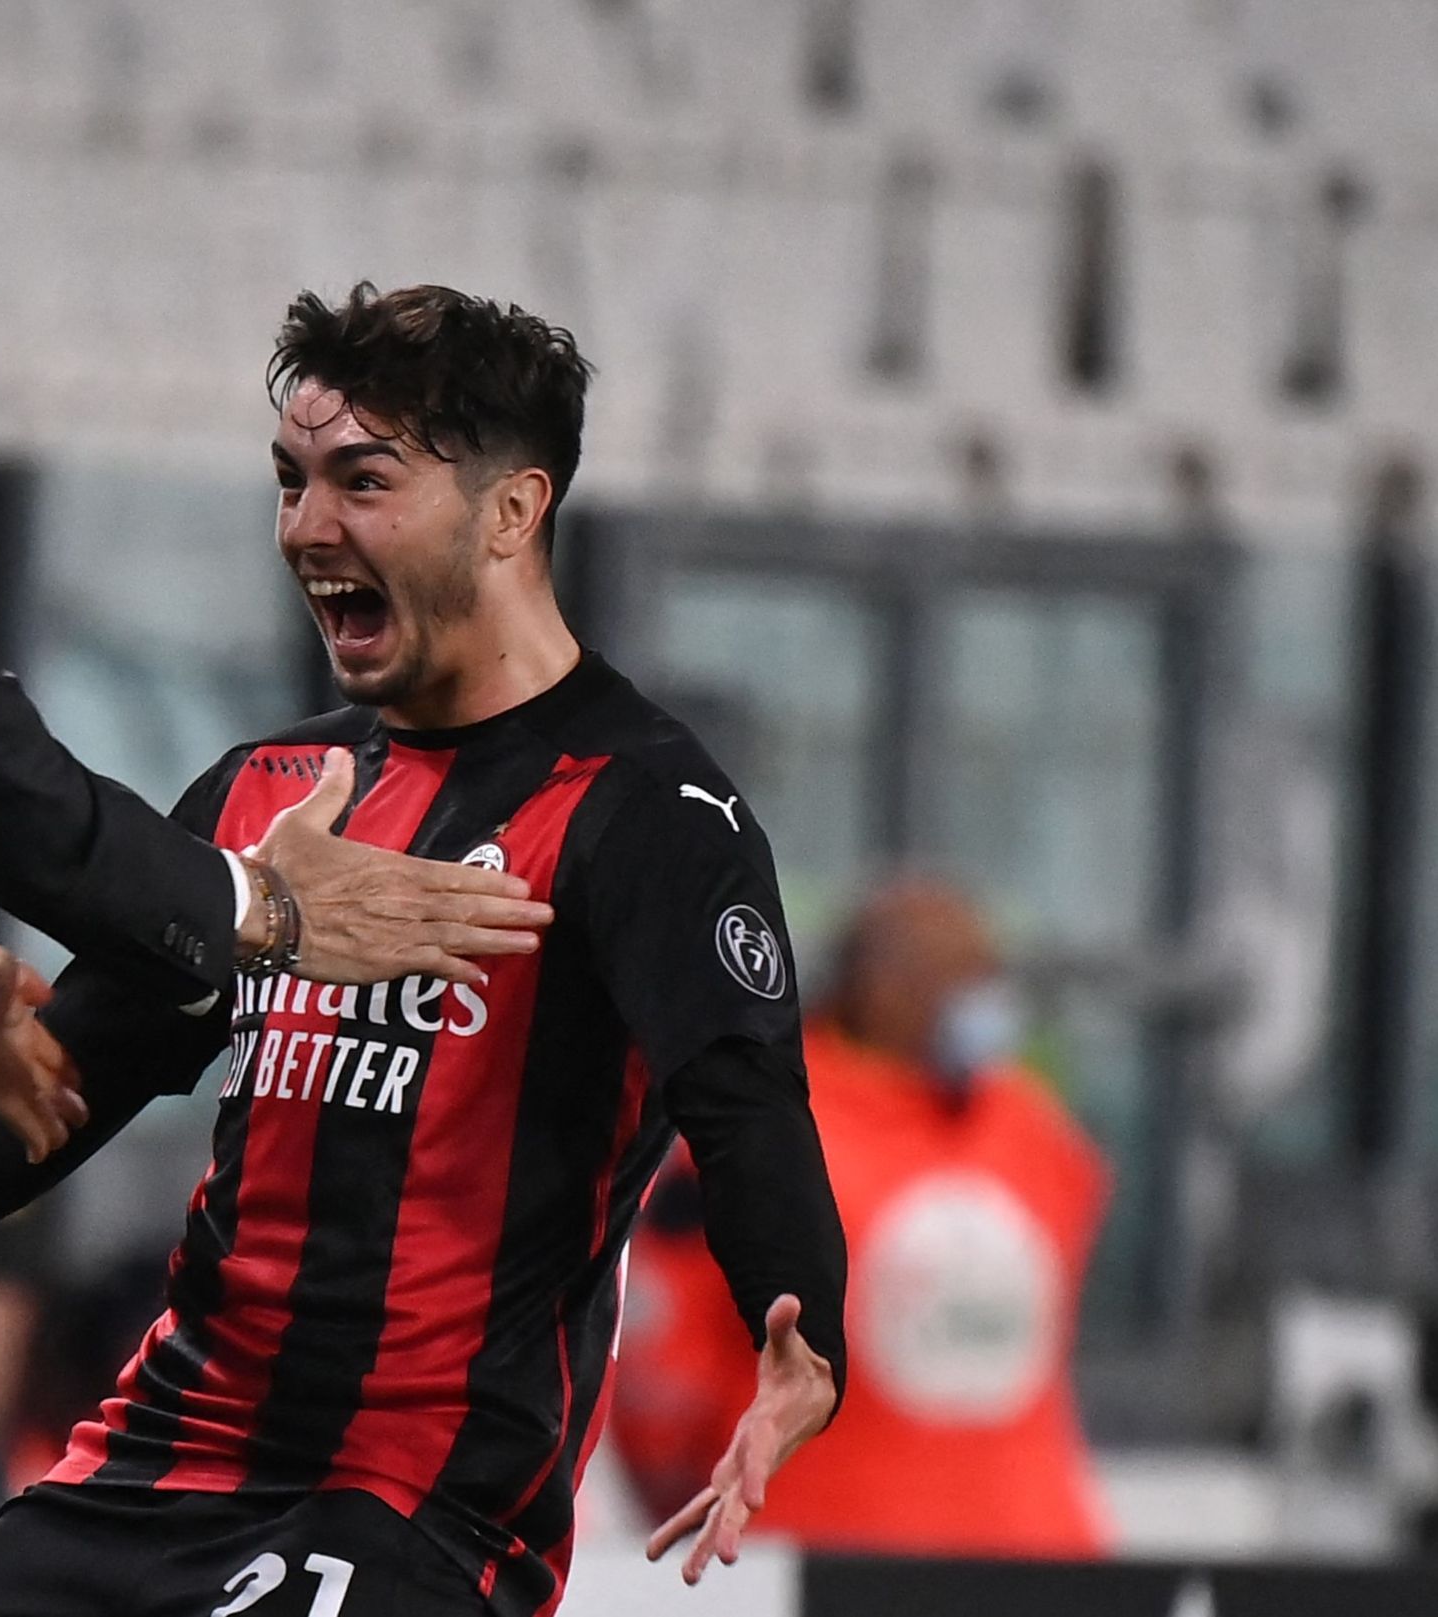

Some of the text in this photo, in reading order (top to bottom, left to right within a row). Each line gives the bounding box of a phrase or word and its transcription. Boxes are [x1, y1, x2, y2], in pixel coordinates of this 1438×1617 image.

[747, 947, 765, 972] 7
[231, 972, 489, 1037] mirates
[252, 1029, 420, 1114] BETTER
[211, 1552, 355, 1617] 21
